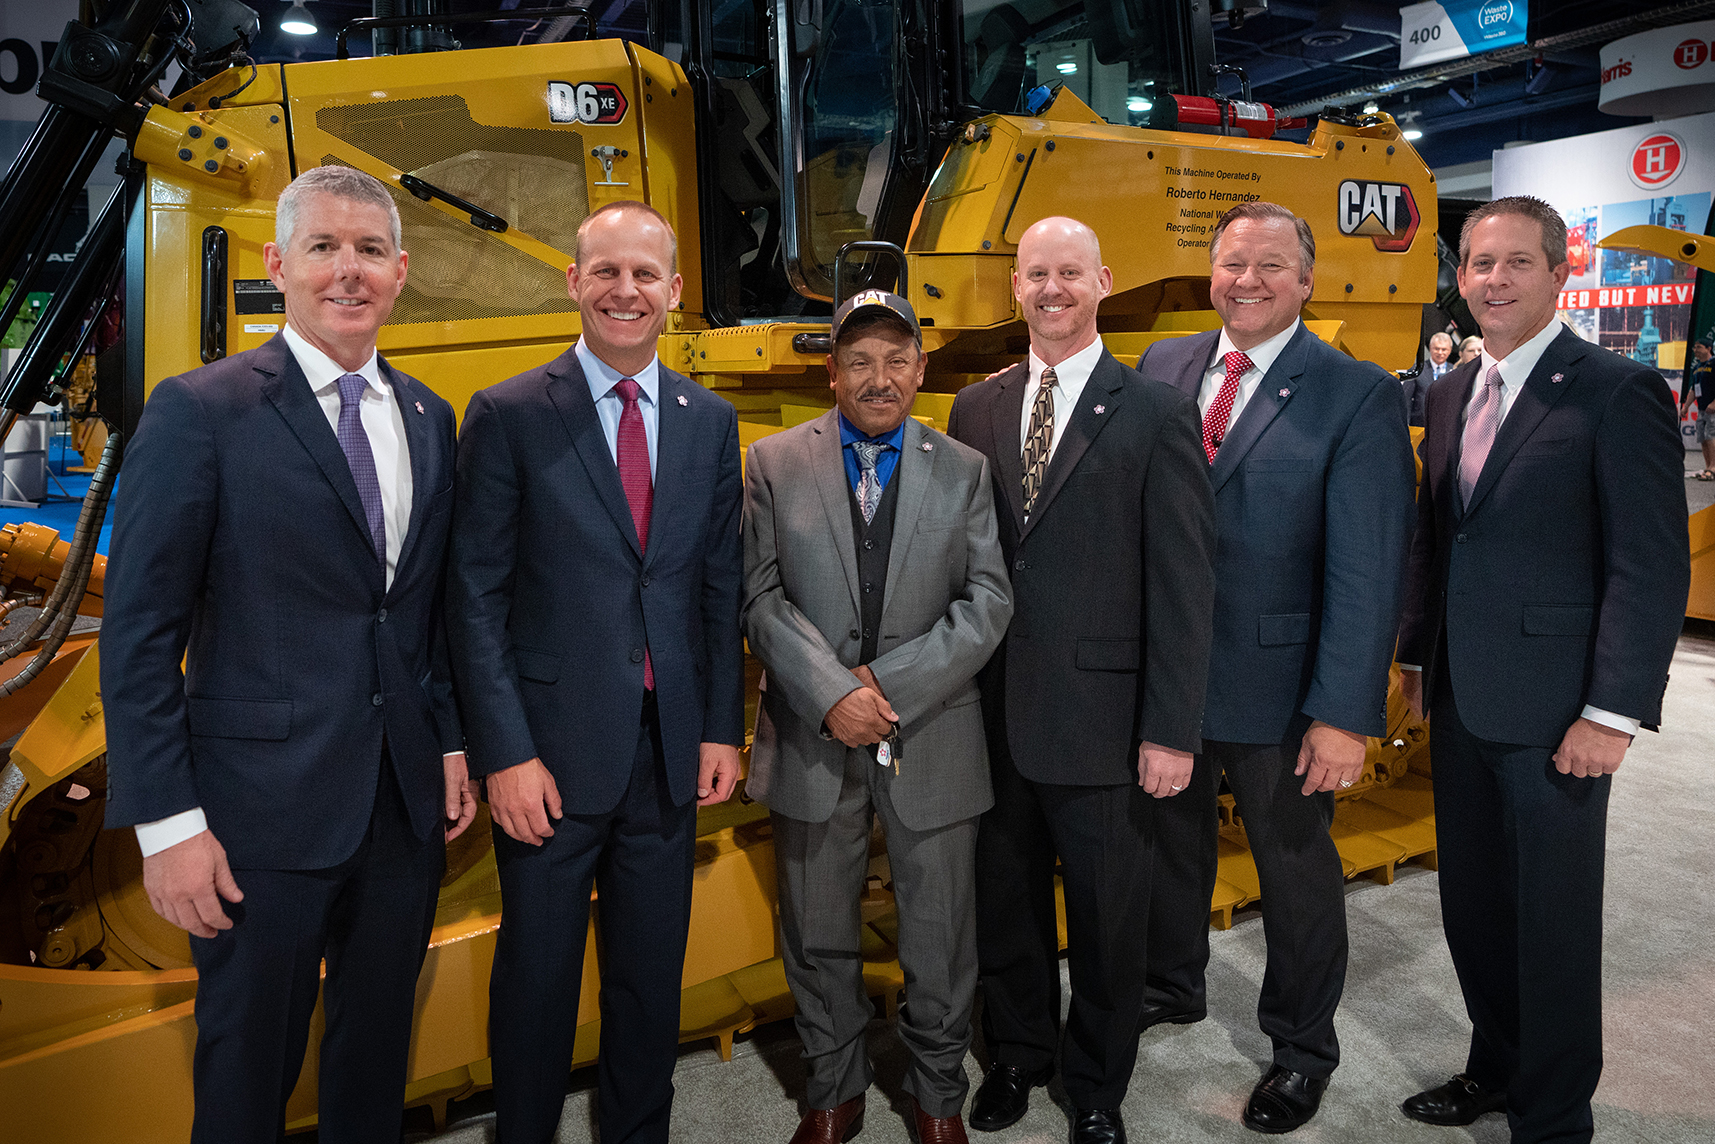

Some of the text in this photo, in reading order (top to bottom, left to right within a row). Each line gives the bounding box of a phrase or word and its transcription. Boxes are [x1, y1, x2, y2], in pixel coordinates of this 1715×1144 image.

[1485, 5, 1508, 15] Waste
[1484, 12, 1508, 25] EXPO
[1409, 25, 1441, 45] 400
[550, 83, 616, 121] D6 XE
[1165, 166, 1261, 183] This Machine Operated By
[1166, 187, 1261, 202] Roberto Hernandez
[1180, 209, 1228, 219] National W
[1340, 181, 1401, 236] CAT
[1166, 223, 1216, 235] Recycling A
[1177, 239, 1210, 249] Operator
[853, 291, 887, 309] CAT
[1598, 288, 1636, 306] BUT
